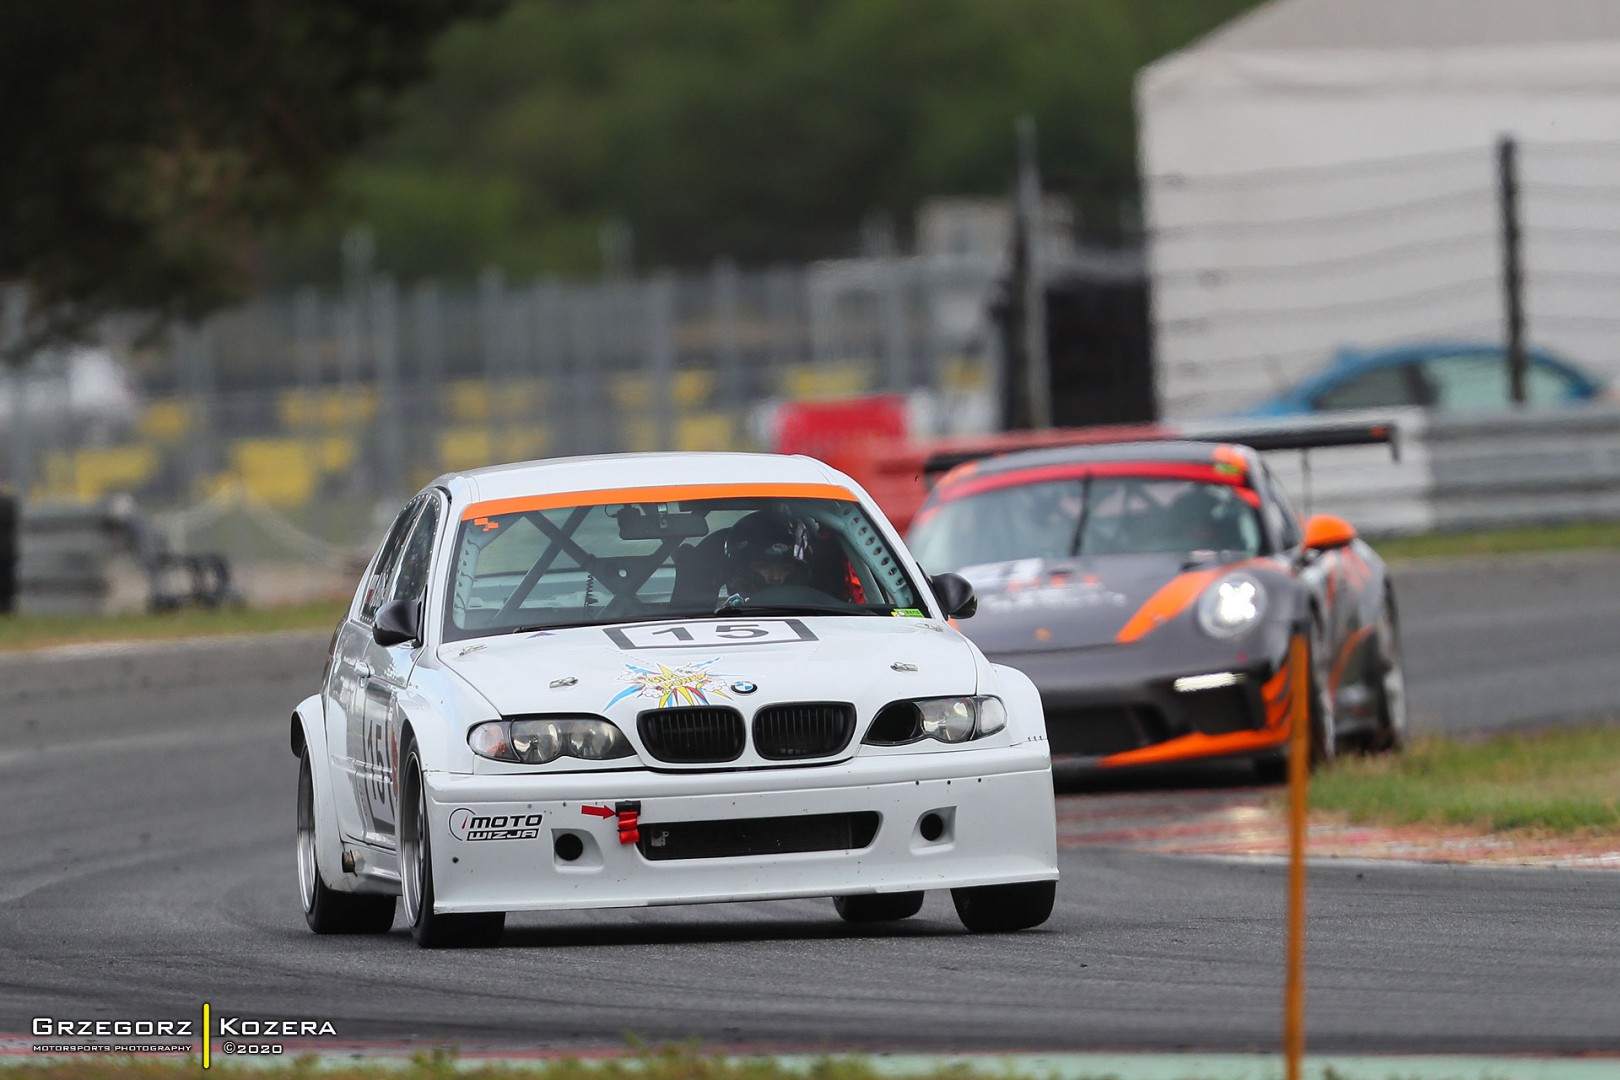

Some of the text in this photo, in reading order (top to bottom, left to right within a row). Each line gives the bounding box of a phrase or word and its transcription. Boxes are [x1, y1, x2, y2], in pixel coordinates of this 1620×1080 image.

[651, 623, 770, 642] 15
[367, 719, 386, 805] 15
[469, 813, 544, 829] MOTO
[468, 829, 540, 841] WIZJA
